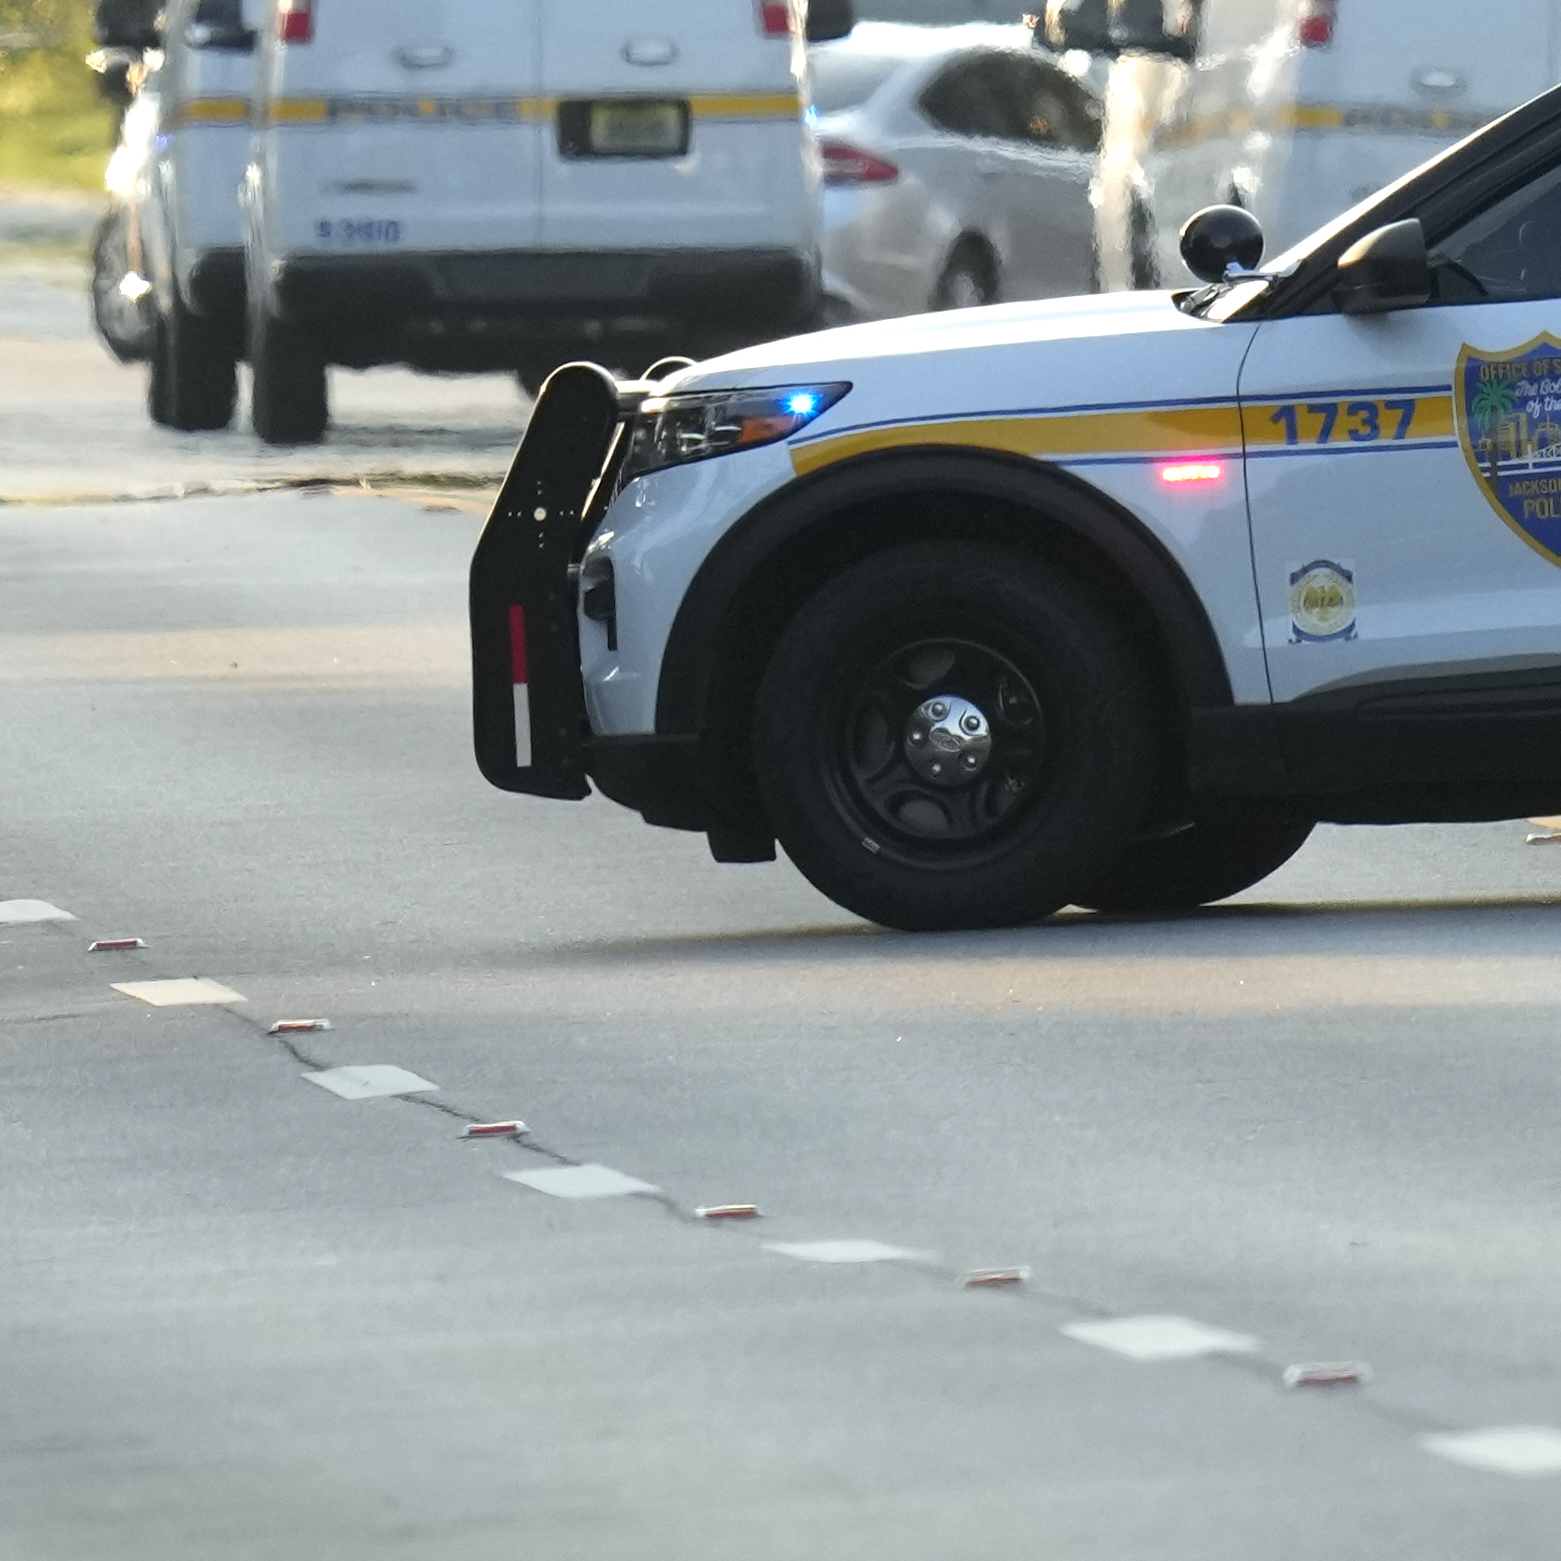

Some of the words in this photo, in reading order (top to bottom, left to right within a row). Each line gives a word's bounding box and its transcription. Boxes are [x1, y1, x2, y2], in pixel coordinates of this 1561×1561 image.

[1480, 360, 1529, 381] OFFICE
[1533, 358, 1551, 376] OF
[1515, 379, 1538, 397] The
[1525, 397, 1543, 419] of
[1270, 399, 1416, 446] 1737
